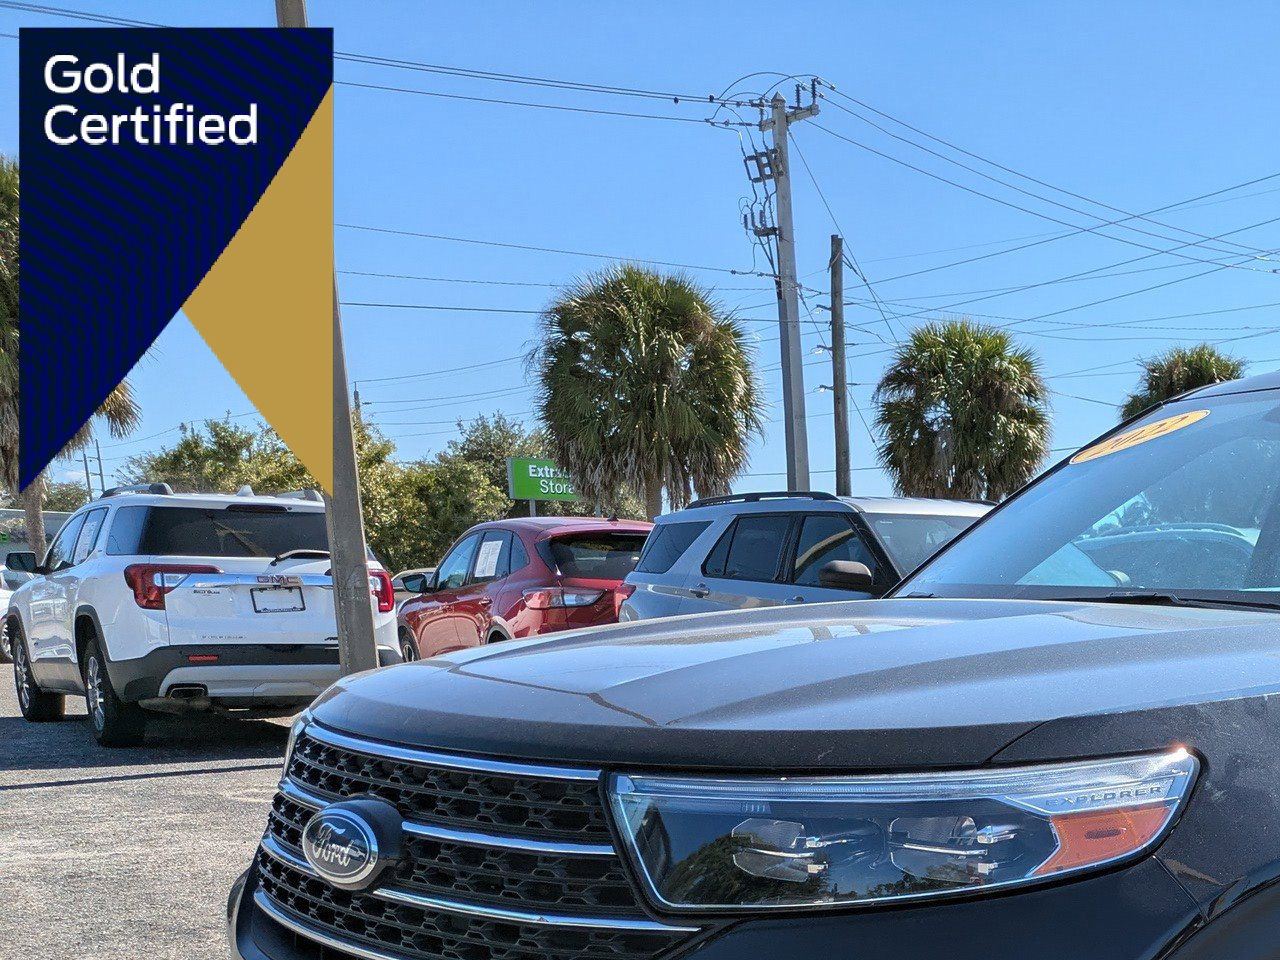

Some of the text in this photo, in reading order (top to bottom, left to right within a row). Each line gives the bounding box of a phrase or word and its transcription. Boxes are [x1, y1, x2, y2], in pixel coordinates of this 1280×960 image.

[256, 575, 300, 584] GMC
[1045, 785, 1163, 807] EXPLORER
[312, 821, 366, 867] Ford
